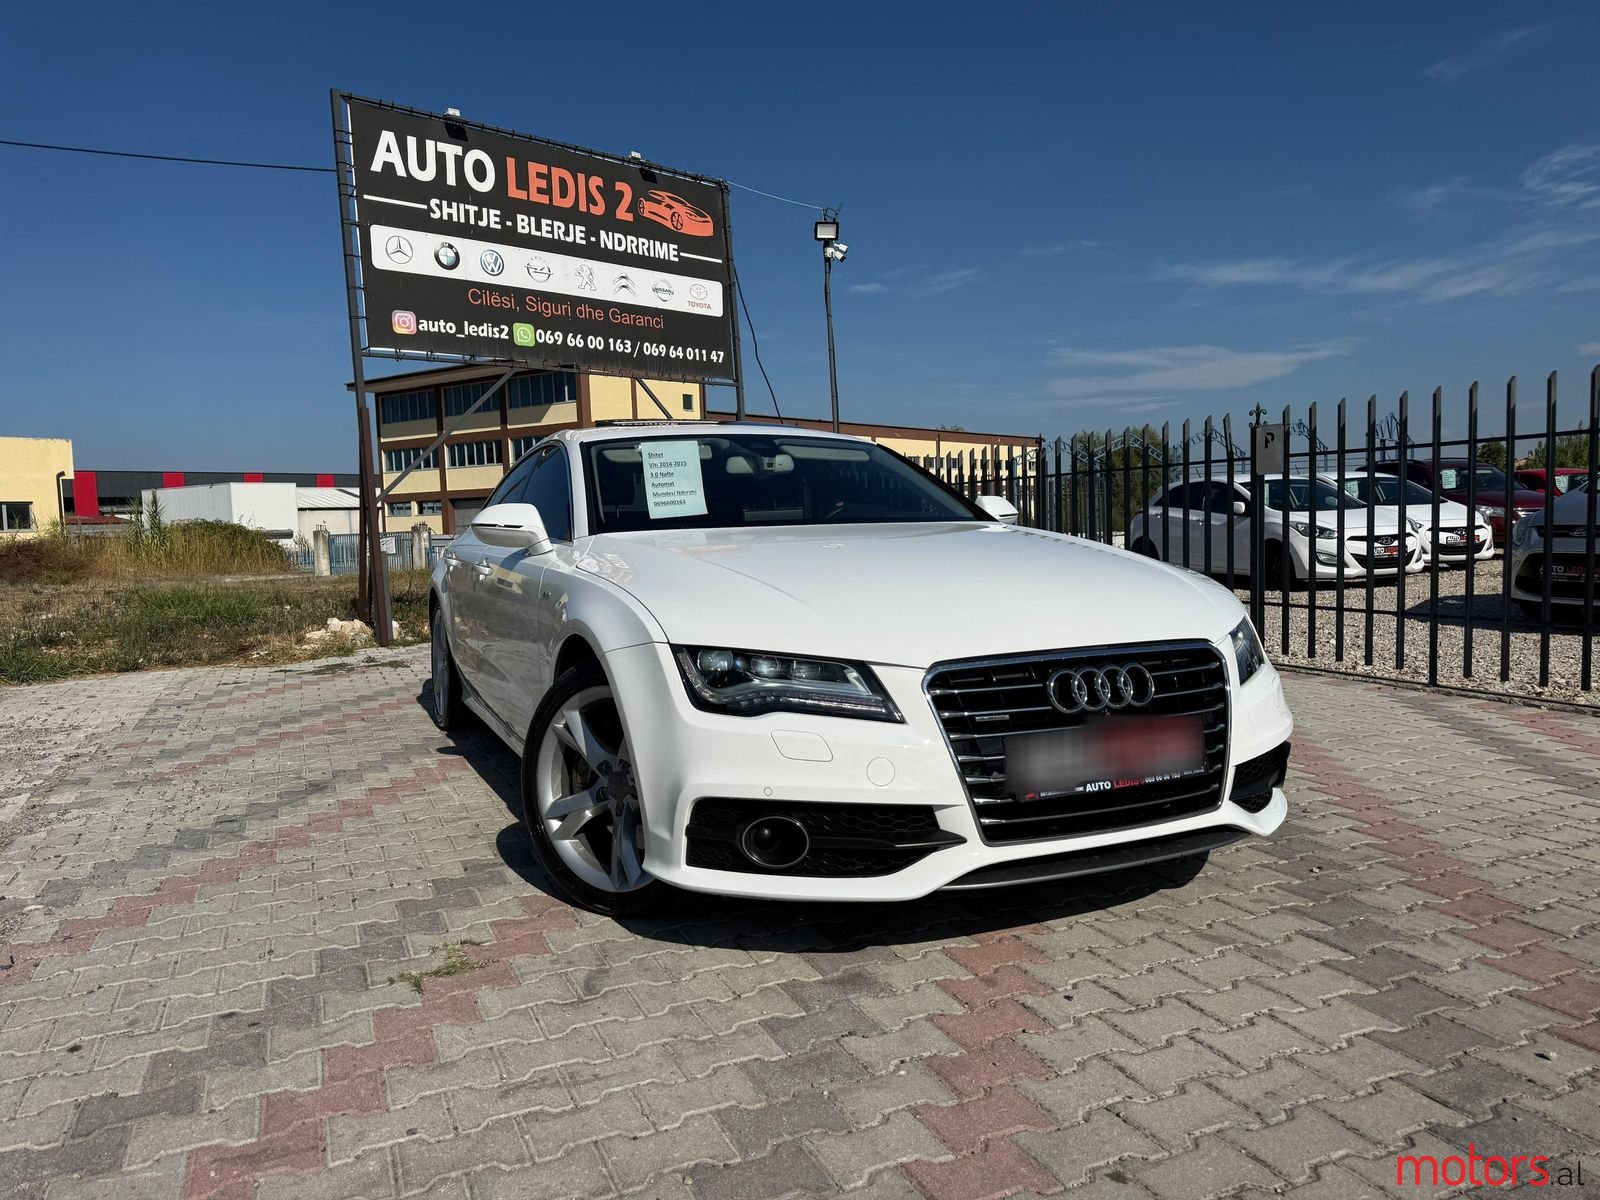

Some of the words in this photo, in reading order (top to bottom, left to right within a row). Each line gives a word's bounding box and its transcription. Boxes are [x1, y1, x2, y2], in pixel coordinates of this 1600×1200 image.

[370, 129, 496, 193] AUTO
[506, 156, 606, 216] LEDIS
[614, 181, 634, 222] 2
[429, 198, 502, 230] SHITJE
[516, 213, 586, 245] BLERJE
[600, 230, 679, 262] NDRRIME
[468, 288, 520, 312] Cilësi,
[576, 303, 604, 321] dhe
[608, 308, 665, 329] Garanci
[688, 301, 712, 310] TOYOTA
[418, 319, 509, 340] auto_ledis2
[536, 328, 563, 345] 069
[566, 332, 585, 348] 66
[587, 335, 604, 350] 00
[608, 338, 632, 353] 163
[643, 342, 667, 357] 069
[669, 345, 684, 359] 64
[686, 347, 707, 362] 011
[710, 350, 724, 363] 47
[1085, 780, 1111, 793] AUTO
